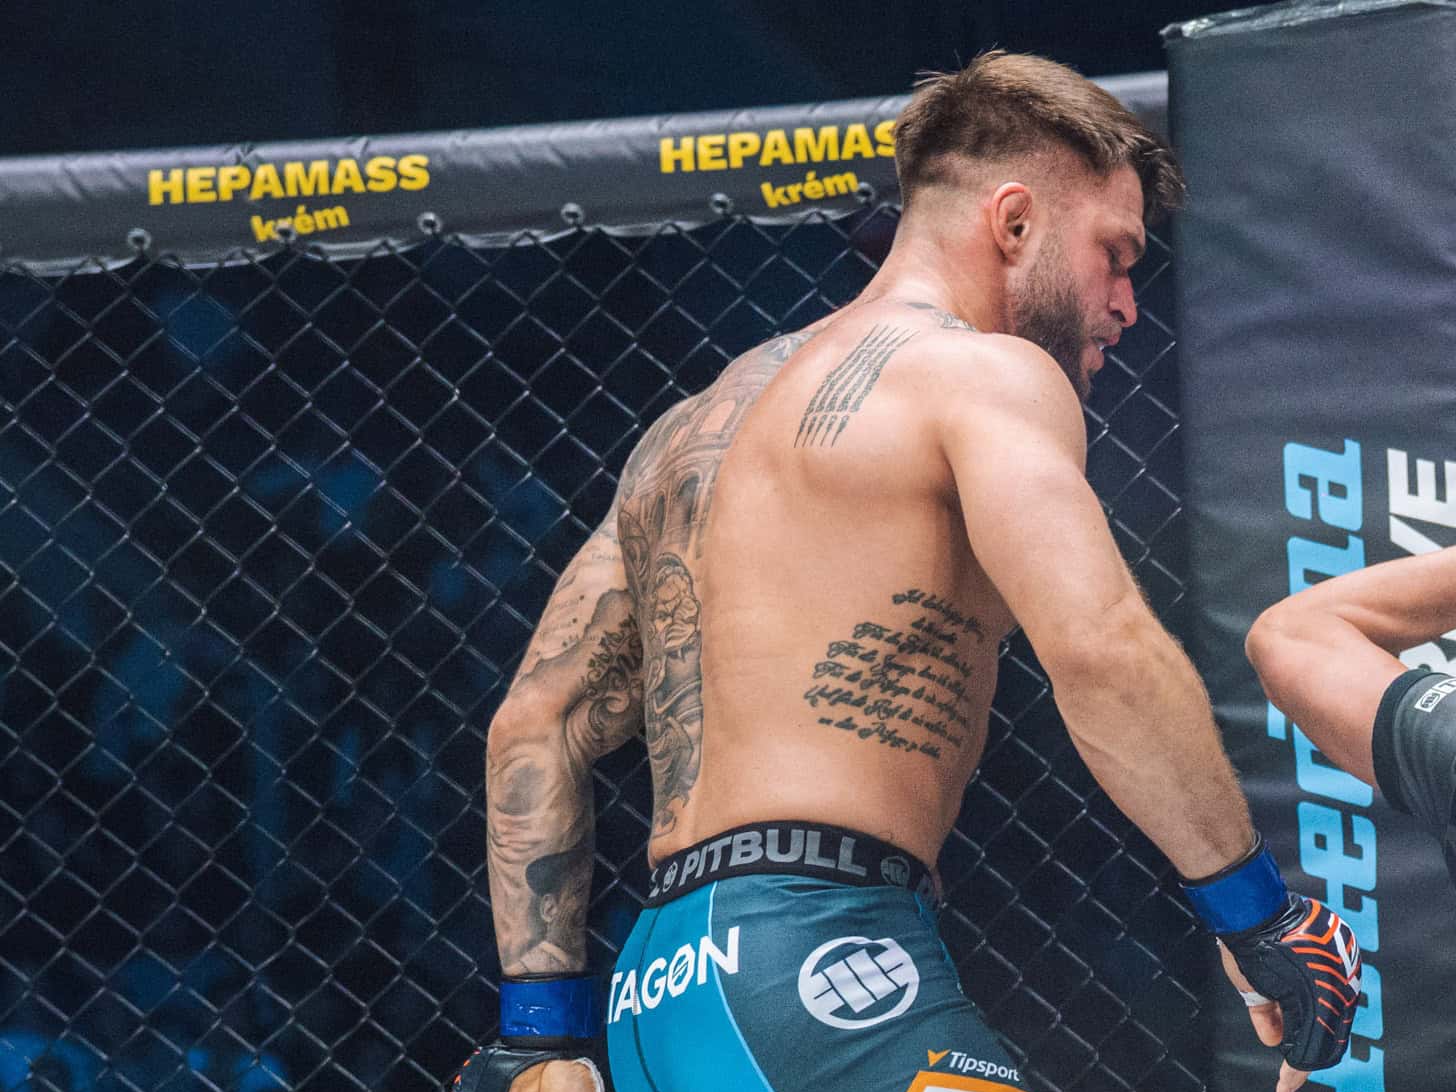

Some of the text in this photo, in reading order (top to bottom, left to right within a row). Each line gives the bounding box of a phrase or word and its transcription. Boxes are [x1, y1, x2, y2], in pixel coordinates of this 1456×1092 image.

[659, 119, 897, 173] HEPAMAS
[147, 153, 430, 206] HEPAMASS
[761, 164, 859, 209] krém
[679, 828, 867, 886] PITBULL
[949, 1051, 1020, 1082] Tipsport
